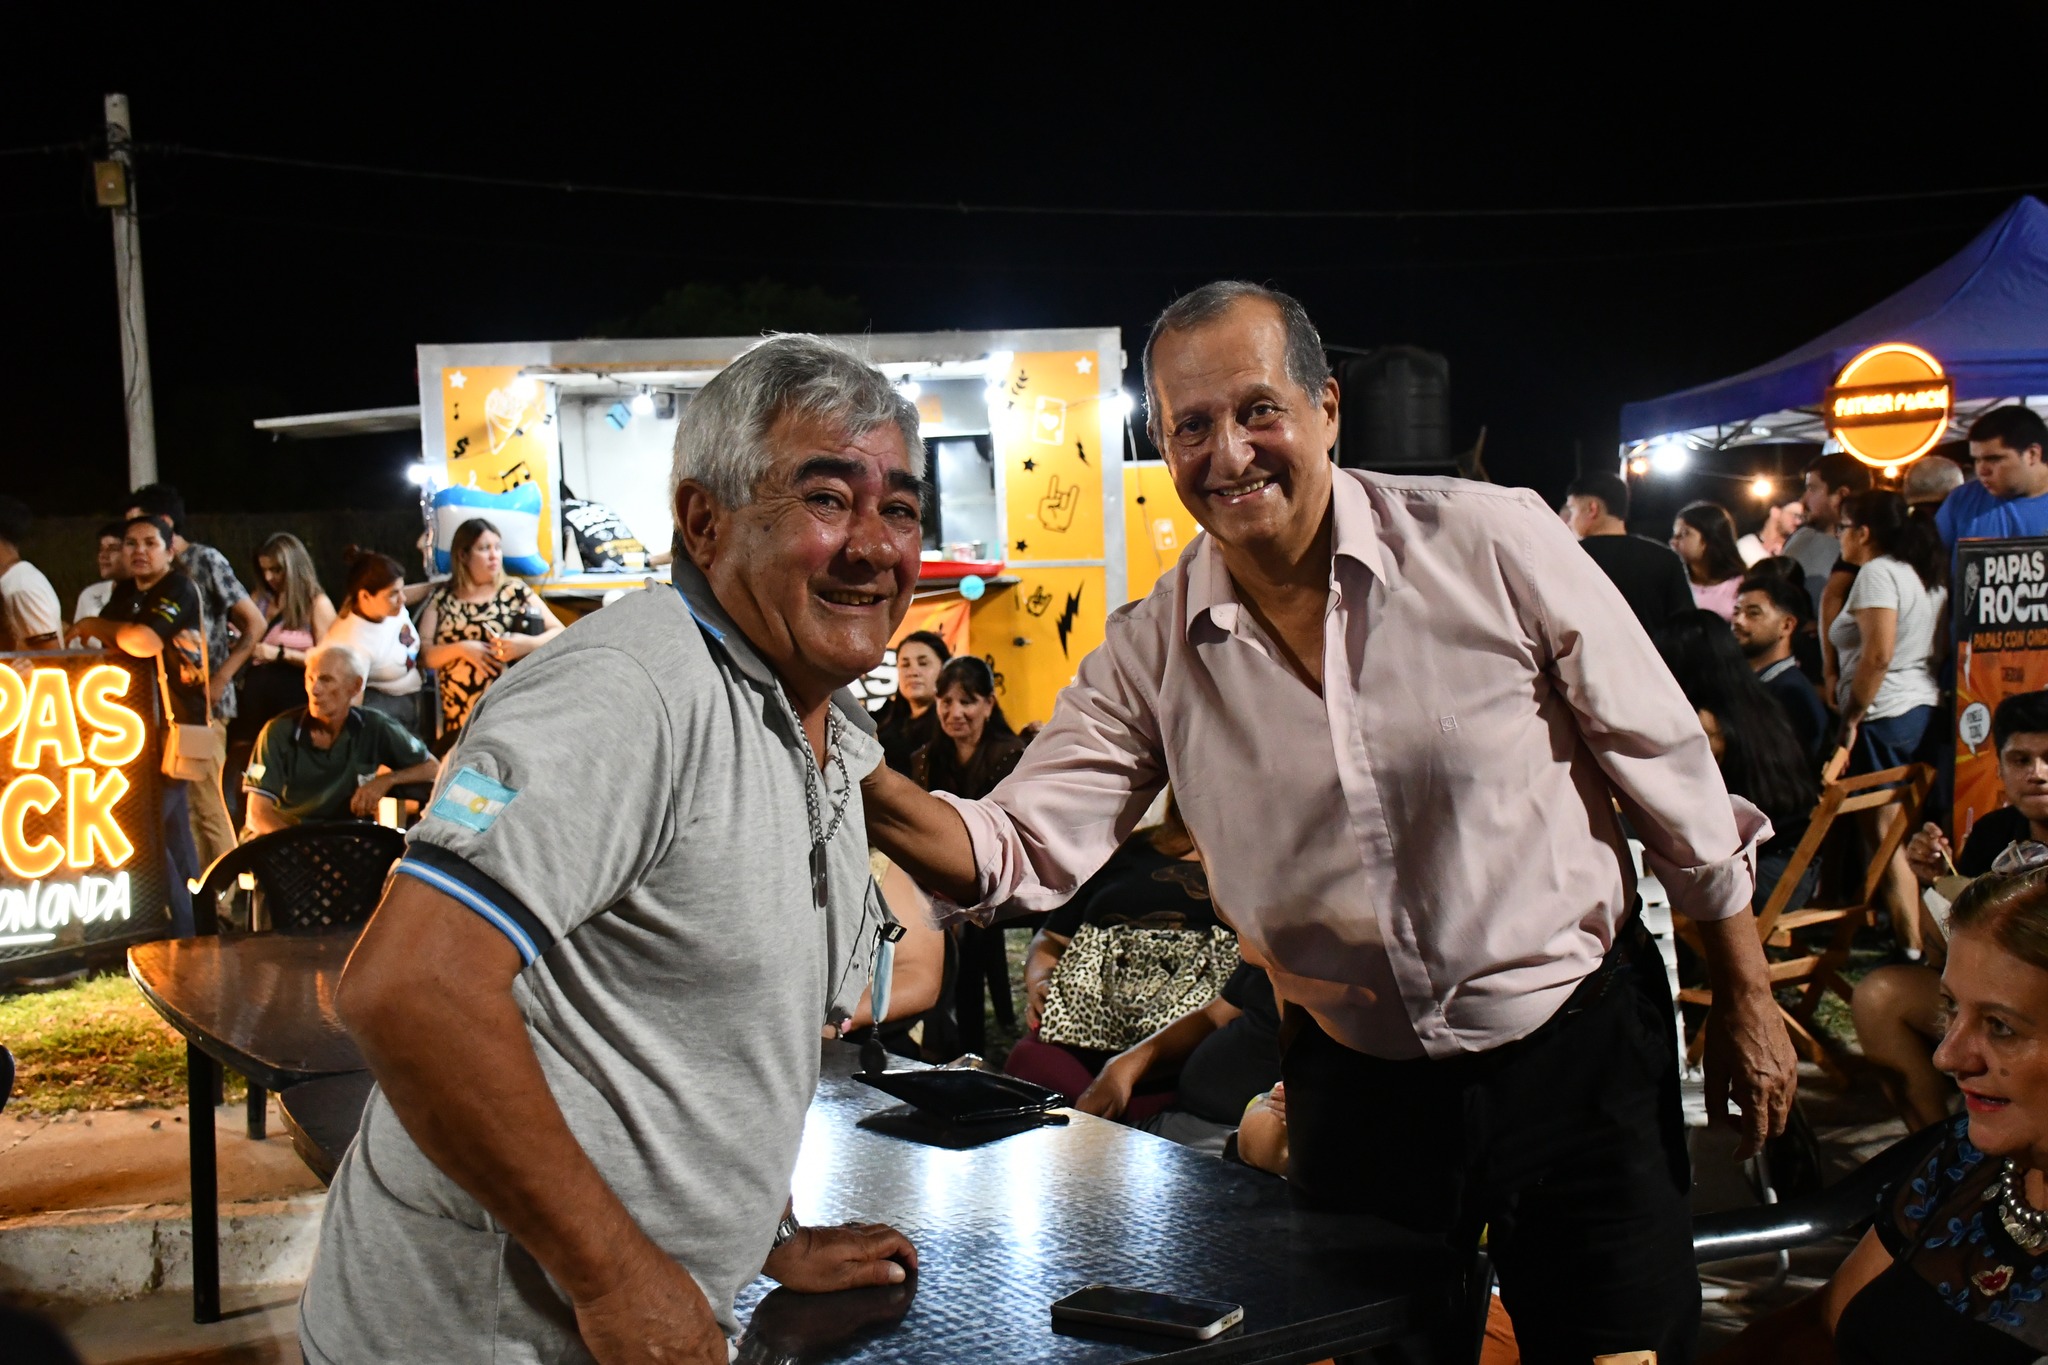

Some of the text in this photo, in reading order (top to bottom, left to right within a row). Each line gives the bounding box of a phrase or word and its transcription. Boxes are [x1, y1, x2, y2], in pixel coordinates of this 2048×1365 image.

[1984, 550, 2046, 586] PAPAS
[1979, 582, 2048, 625] ROCK
[38, 870, 131, 930] ONDA
